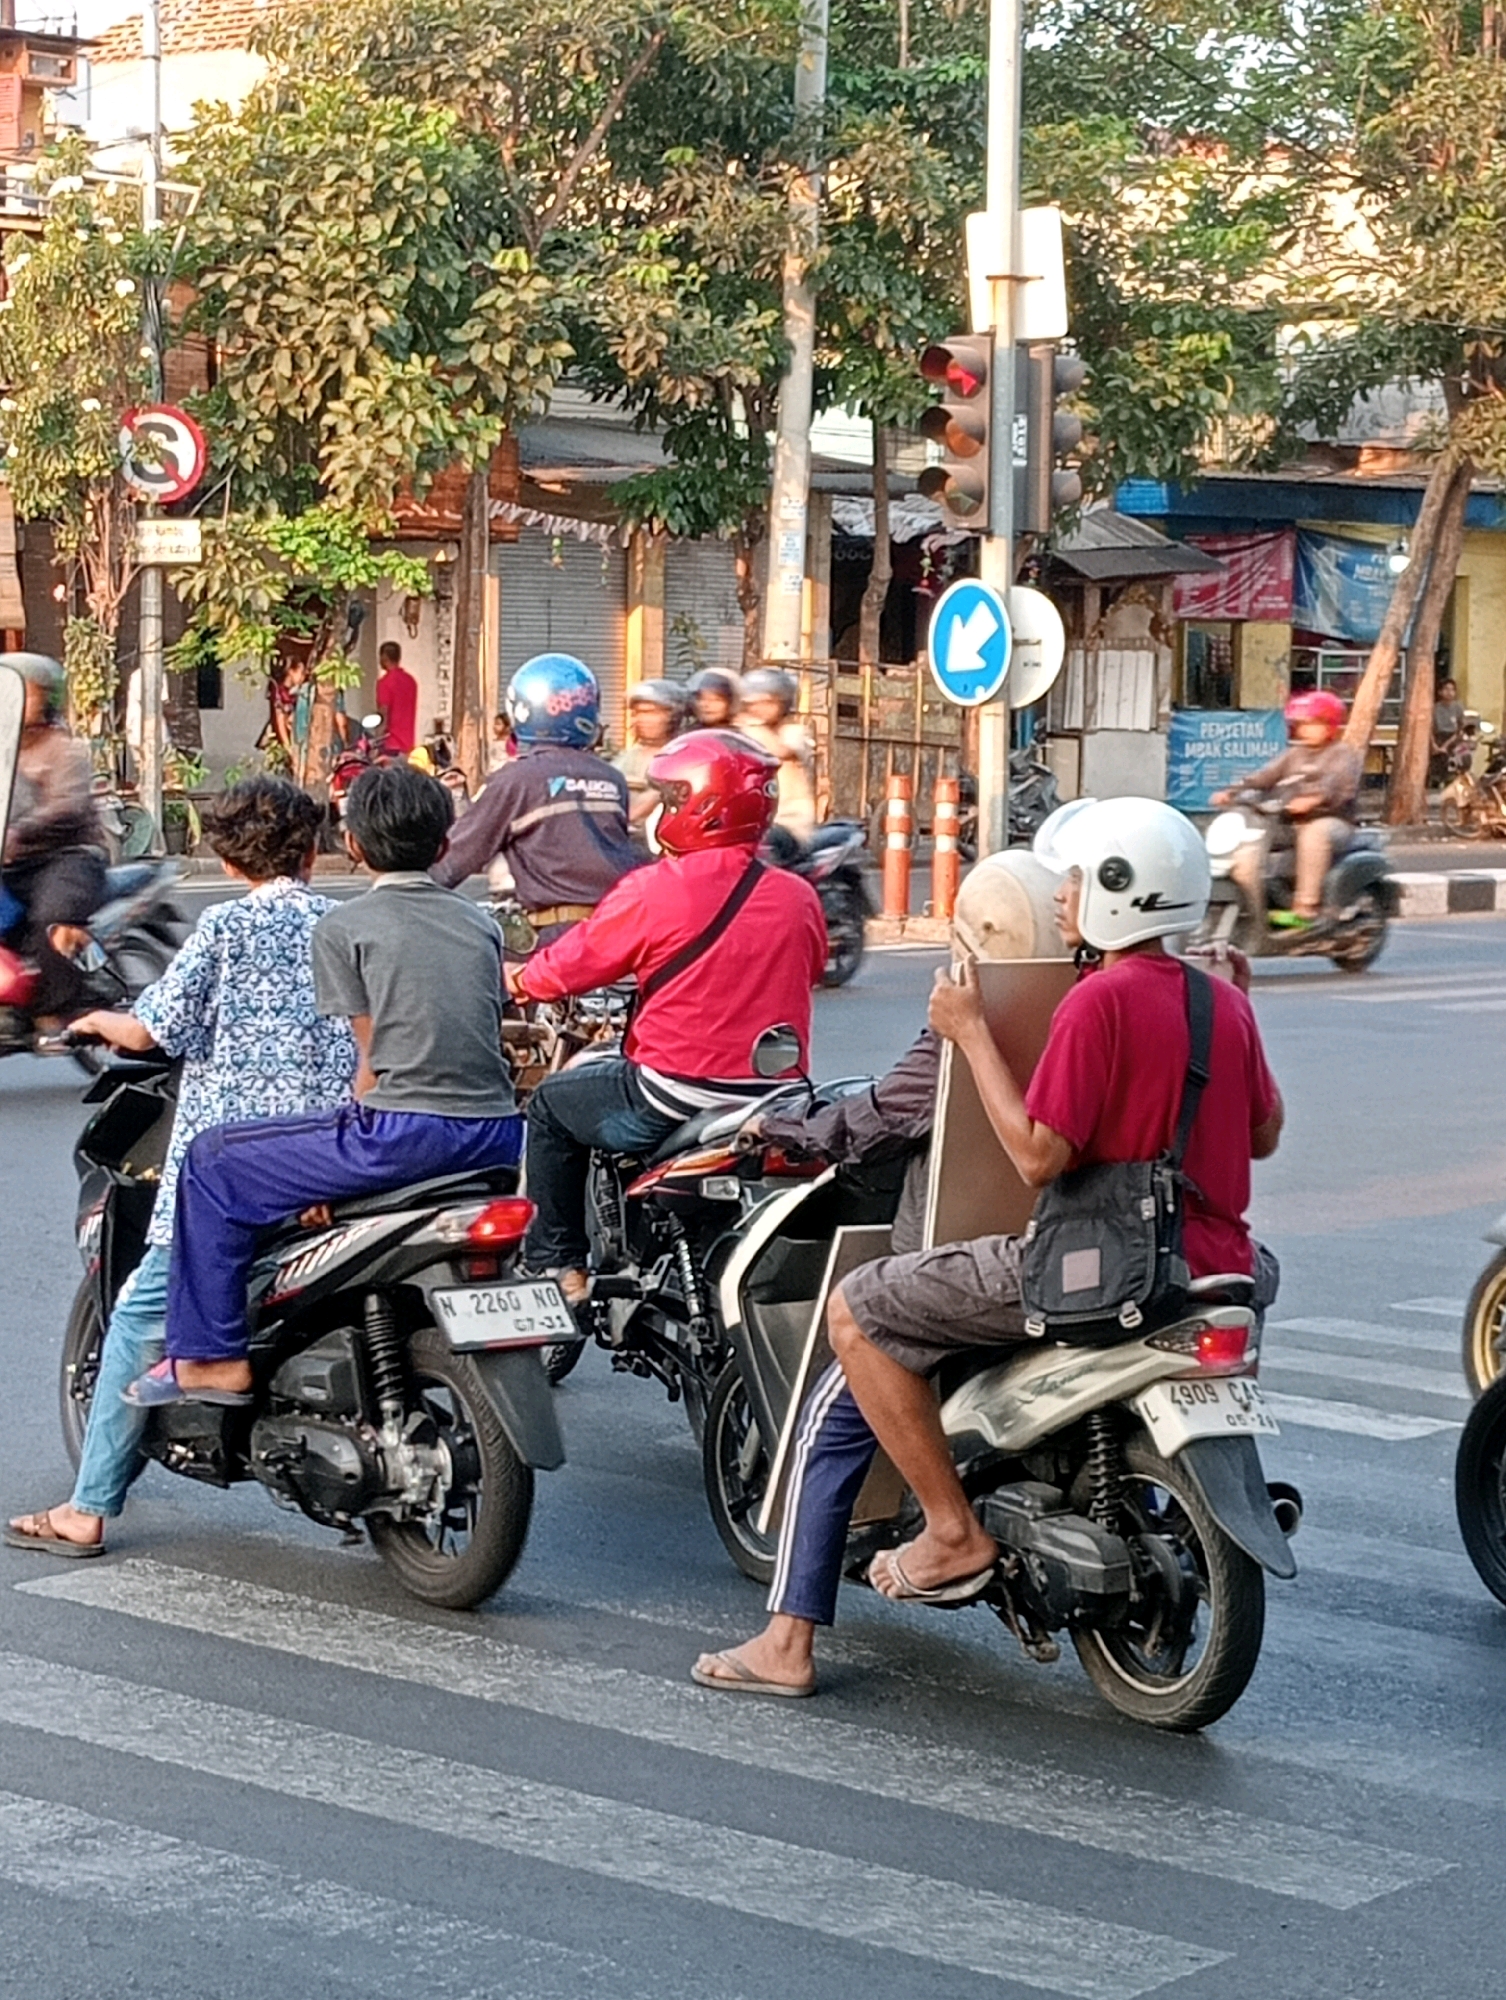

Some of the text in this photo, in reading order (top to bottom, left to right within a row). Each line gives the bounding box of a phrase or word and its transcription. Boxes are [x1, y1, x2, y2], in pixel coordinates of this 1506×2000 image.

[1201, 722, 1264, 739] PENYETAN
[1184, 741, 1279, 758] MBAK SALIMAH
[439, 1296, 457, 1319] N
[469, 1290, 521, 1315] 2260
[1143, 1401, 1159, 1423] L
[1170, 1383, 1219, 1405] 4909
